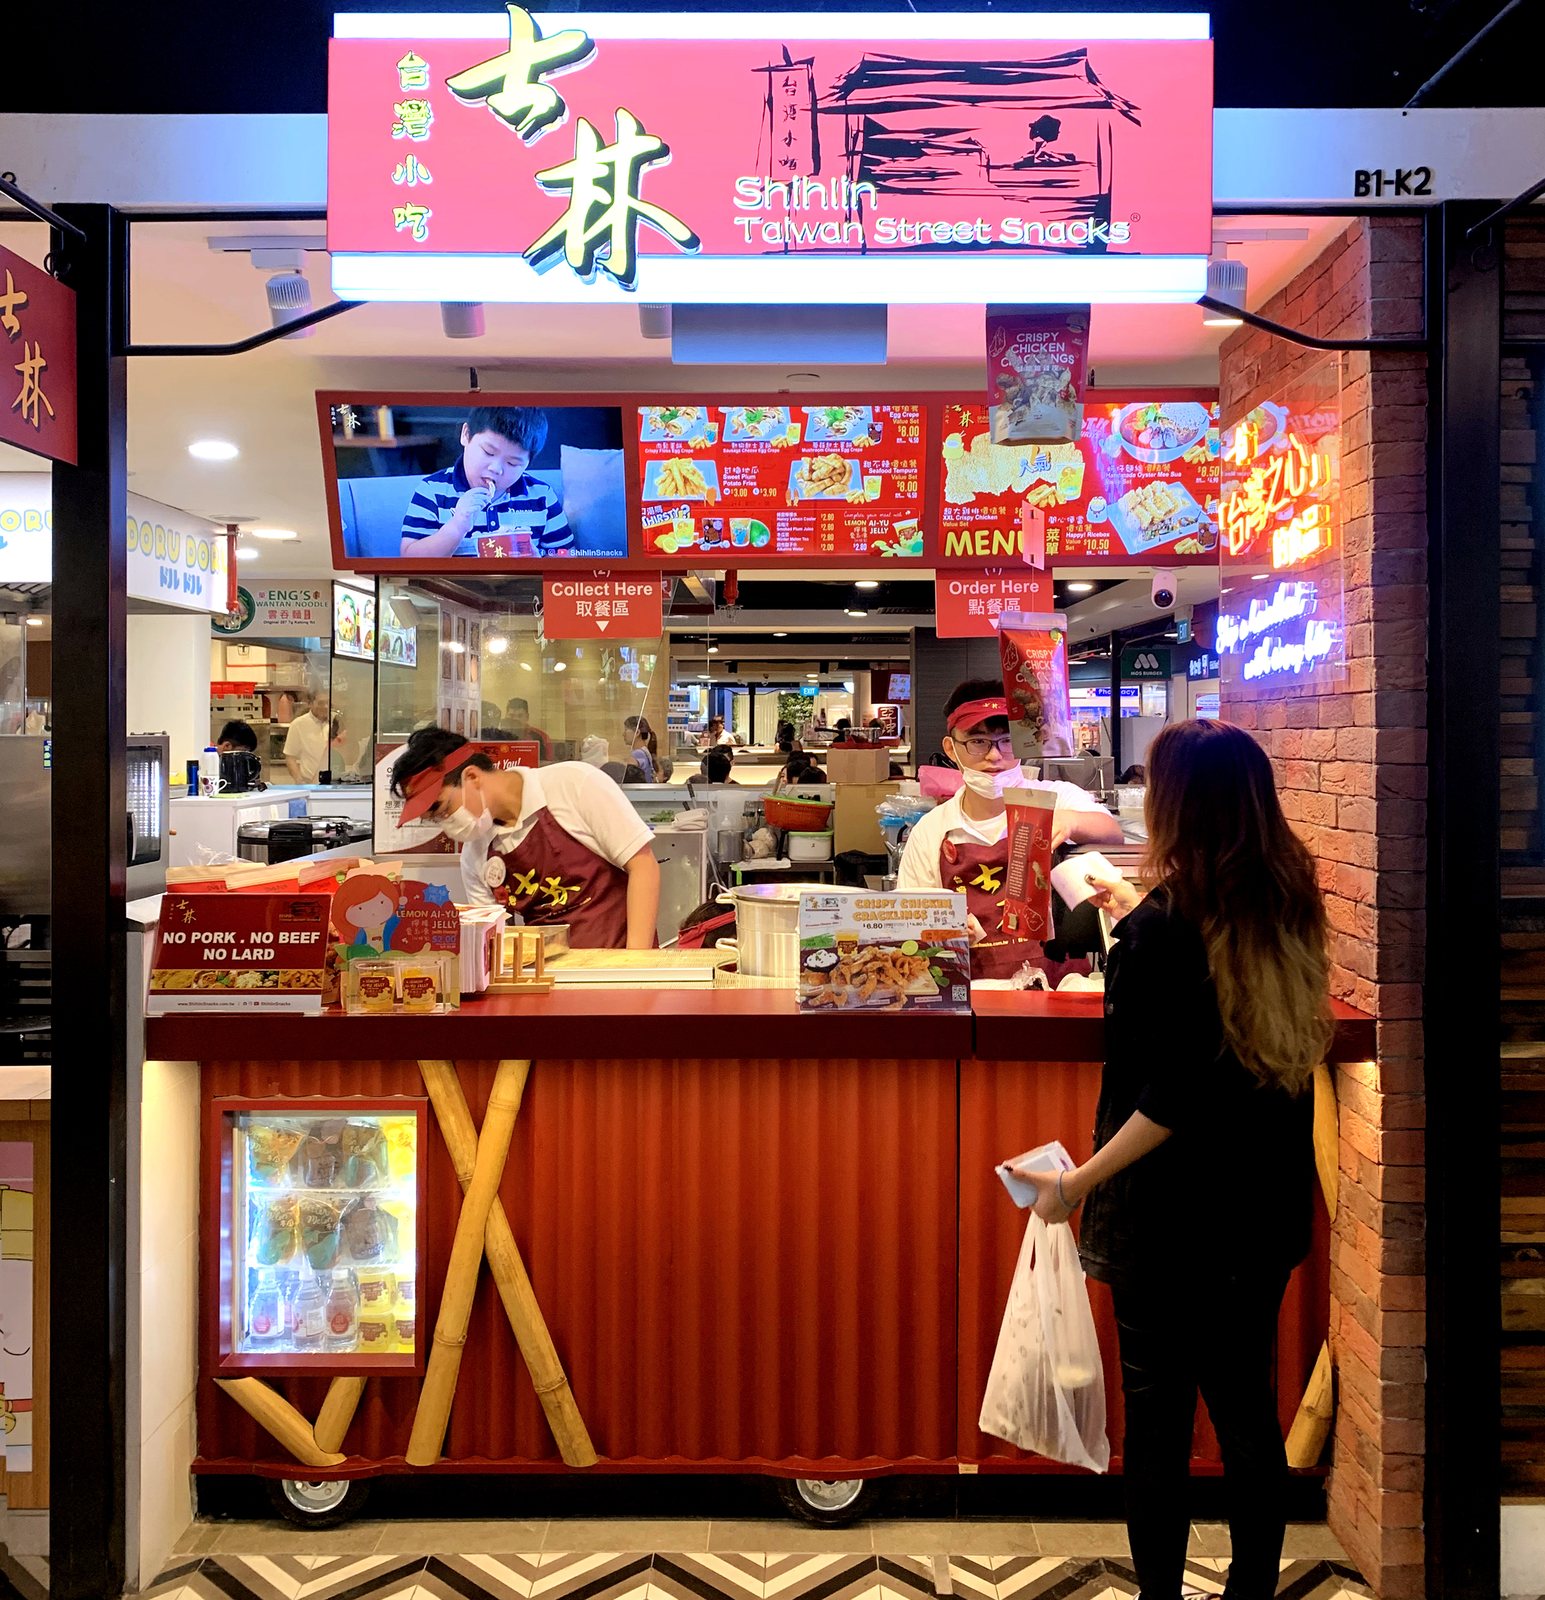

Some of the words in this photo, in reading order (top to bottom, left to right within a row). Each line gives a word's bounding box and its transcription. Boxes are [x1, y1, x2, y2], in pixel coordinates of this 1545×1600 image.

[445, 2, 702, 291] 士林
[1354, 166, 1432, 197] B1-K2
[733, 175, 878, 211] Shihlin
[733, 216, 865, 244] Taiwan
[873, 216, 993, 244] Street
[999, 216, 1132, 244] Snacks
[1016, 332, 1059, 343] CRISPY
[1011, 342, 1065, 354] CHICKEN
[870, 527, 889, 535] JELLY
[127, 516, 180, 564] DORU
[944, 529, 1023, 557] MEN
[1045, 527, 1061, 556] 菜單
[1083, 539, 1110, 551] $10.50
[570, 549, 623, 557] ShihlinSnacks
[551, 582, 610, 597] Collect
[614, 581, 653, 597] Here
[949, 580, 996, 595] Order
[1001, 580, 1039, 594] Here
[268, 590, 311, 600] ENG'S
[575, 600, 630, 618] 取餐區
[968, 598, 1021, 615] 點餐區
[1025, 649, 1054, 659] CRISPY
[503, 757, 521, 770] You!
[854, 899, 898, 910] CRISPY
[396, 910, 428, 918] LEMON
[431, 910, 458, 919] AI-YU
[852, 910, 929, 921] CRACKLINGS
[432, 920, 458, 929] JELLY
[163, 932, 187, 944] NO
[191, 931, 236, 944] PORK
[250, 931, 274, 944] NO
[278, 931, 320, 944] BEEF
[203, 948, 228, 960] NO
[231, 948, 275, 961] LARD
